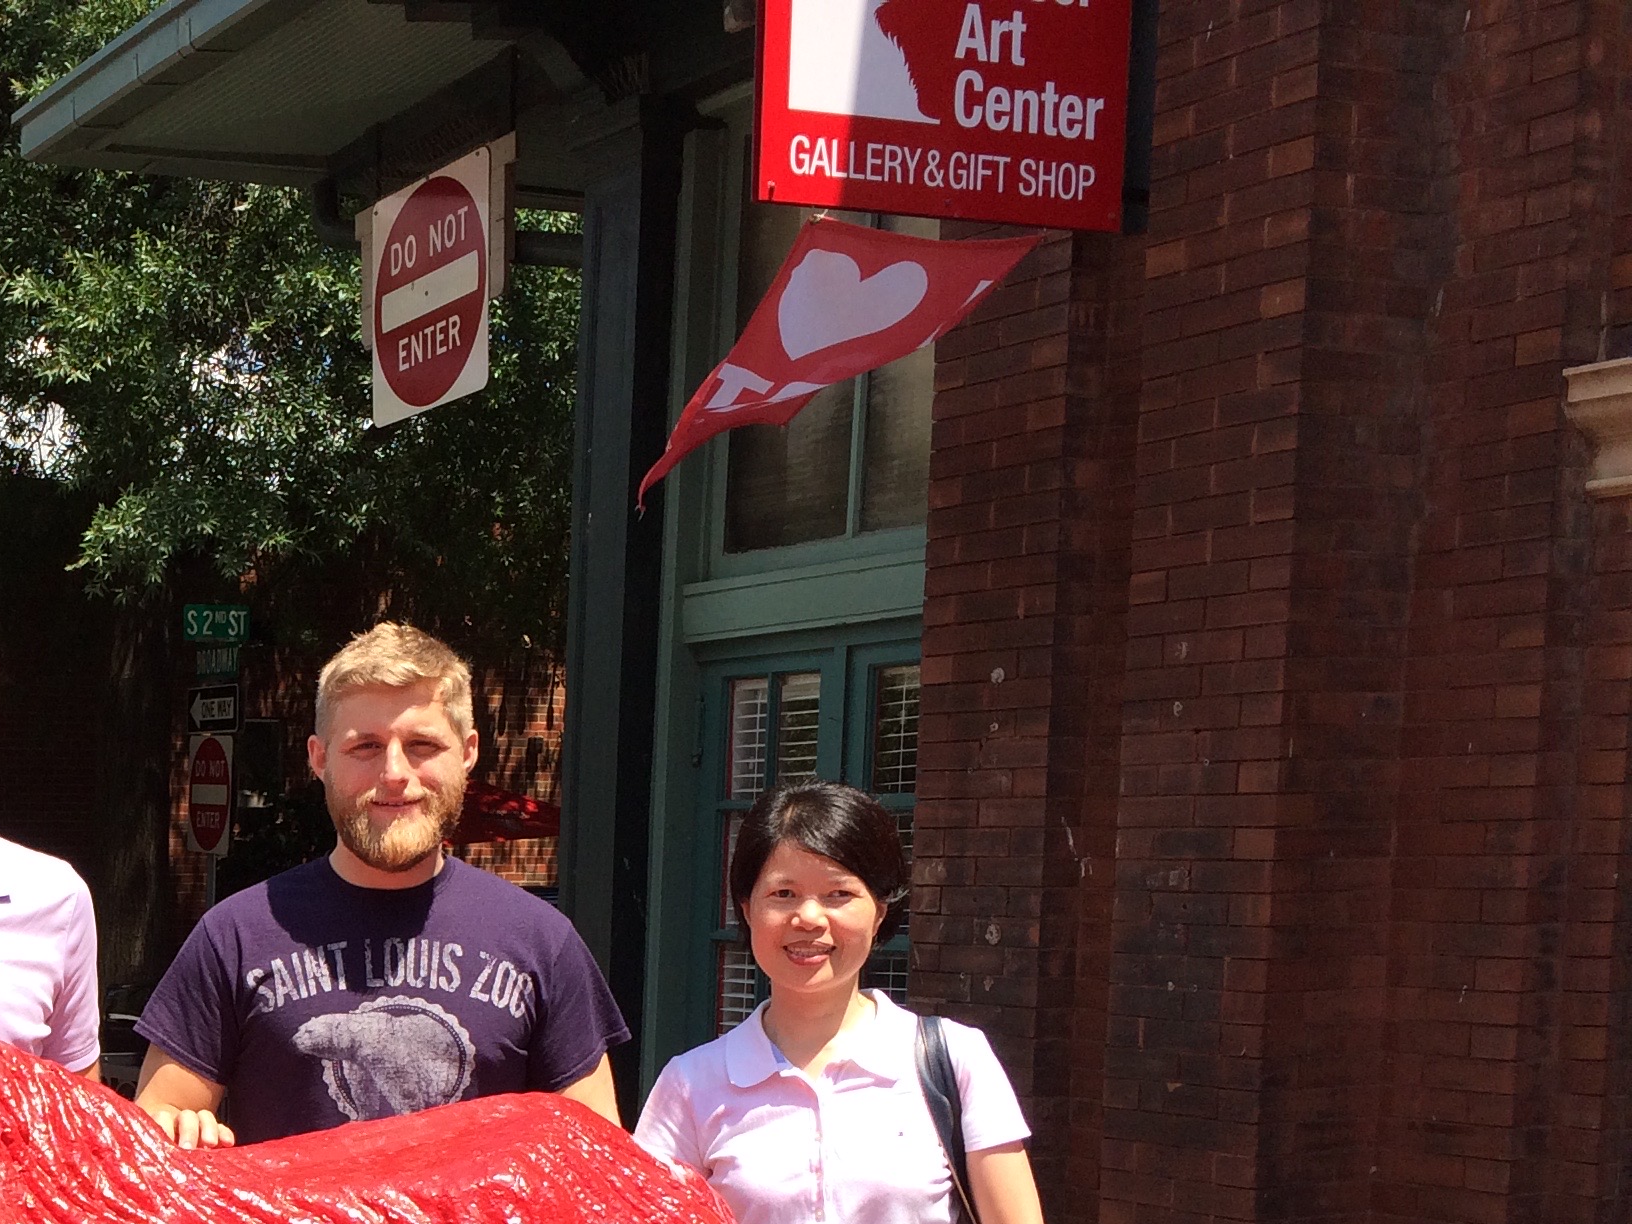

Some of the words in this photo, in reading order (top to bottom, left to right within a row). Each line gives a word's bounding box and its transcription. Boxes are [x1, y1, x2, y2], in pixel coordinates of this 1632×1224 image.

[955, 3, 1027, 67] Art
[954, 69, 1105, 141] Center
[789, 134, 922, 185] GALLERY
[923, 149, 945, 188] &
[948, 150, 1011, 193] GIFT
[1018, 158, 1096, 200] SHOP
[390, 234, 417, 277] DO
[429, 205, 468, 257] NOT
[398, 314, 461, 372] ENTER
[186, 610, 198, 636] S
[228, 610, 248, 636] ST
[196, 647, 239, 676] BROADWAY
[201, 701, 216, 718] ONE
[218, 698, 234, 717] WAY
[195, 761, 206, 777] DO
[208, 760, 226, 777] NOT
[196, 812, 219, 829] ENTER
[246, 940, 348, 1013] SAINT
[364, 937, 464, 993] LOUIS
